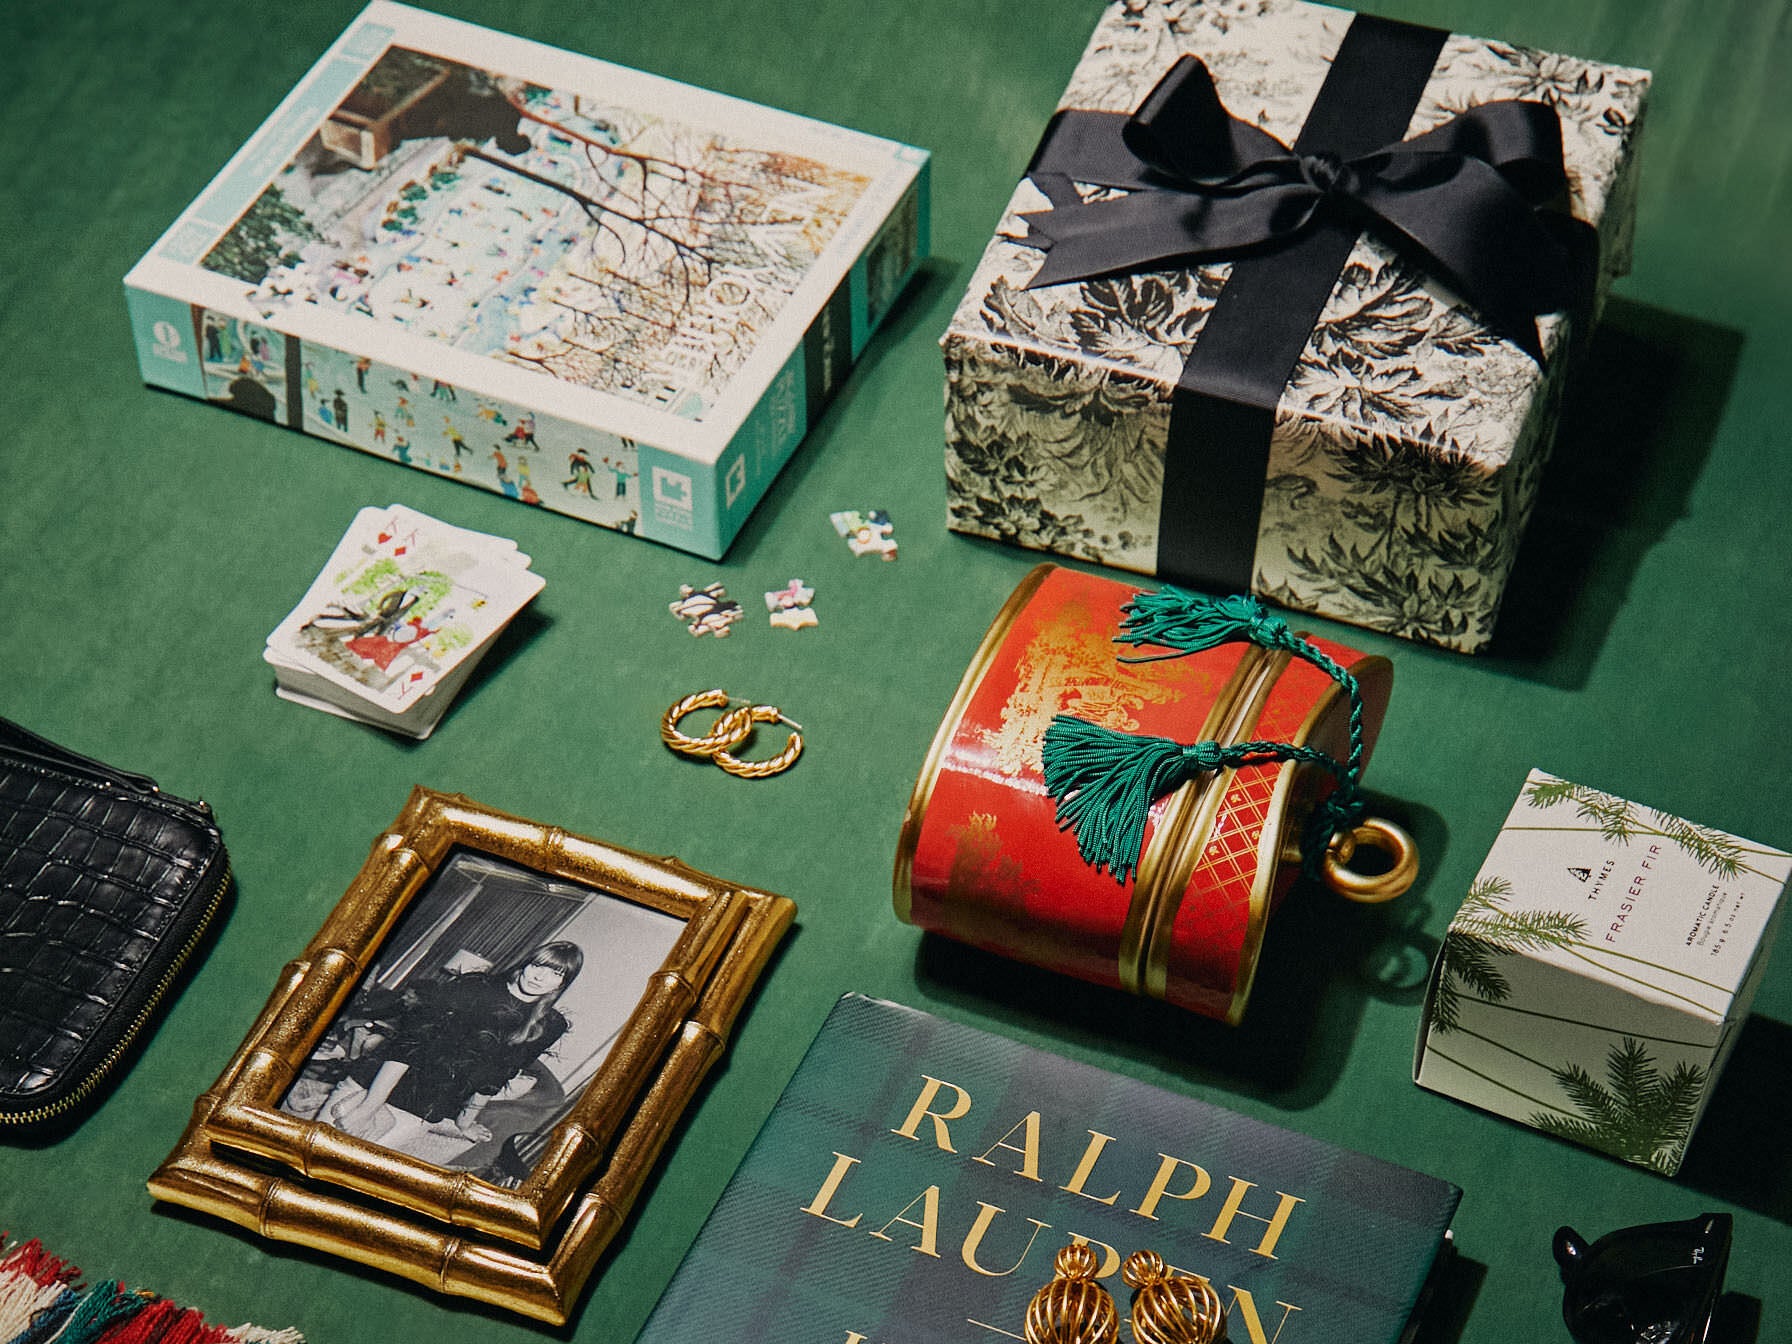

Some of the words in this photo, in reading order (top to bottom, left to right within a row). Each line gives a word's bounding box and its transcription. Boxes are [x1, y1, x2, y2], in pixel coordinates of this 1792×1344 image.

[1588, 858, 1615, 901] THYMES
[1605, 875, 1646, 943] FRASIER
[1641, 843, 1661, 869] FIR
[1685, 911, 1706, 946] AROMATIC
[1701, 884, 1719, 911] CANDLE
[889, 1073, 1306, 1260] RALPH
